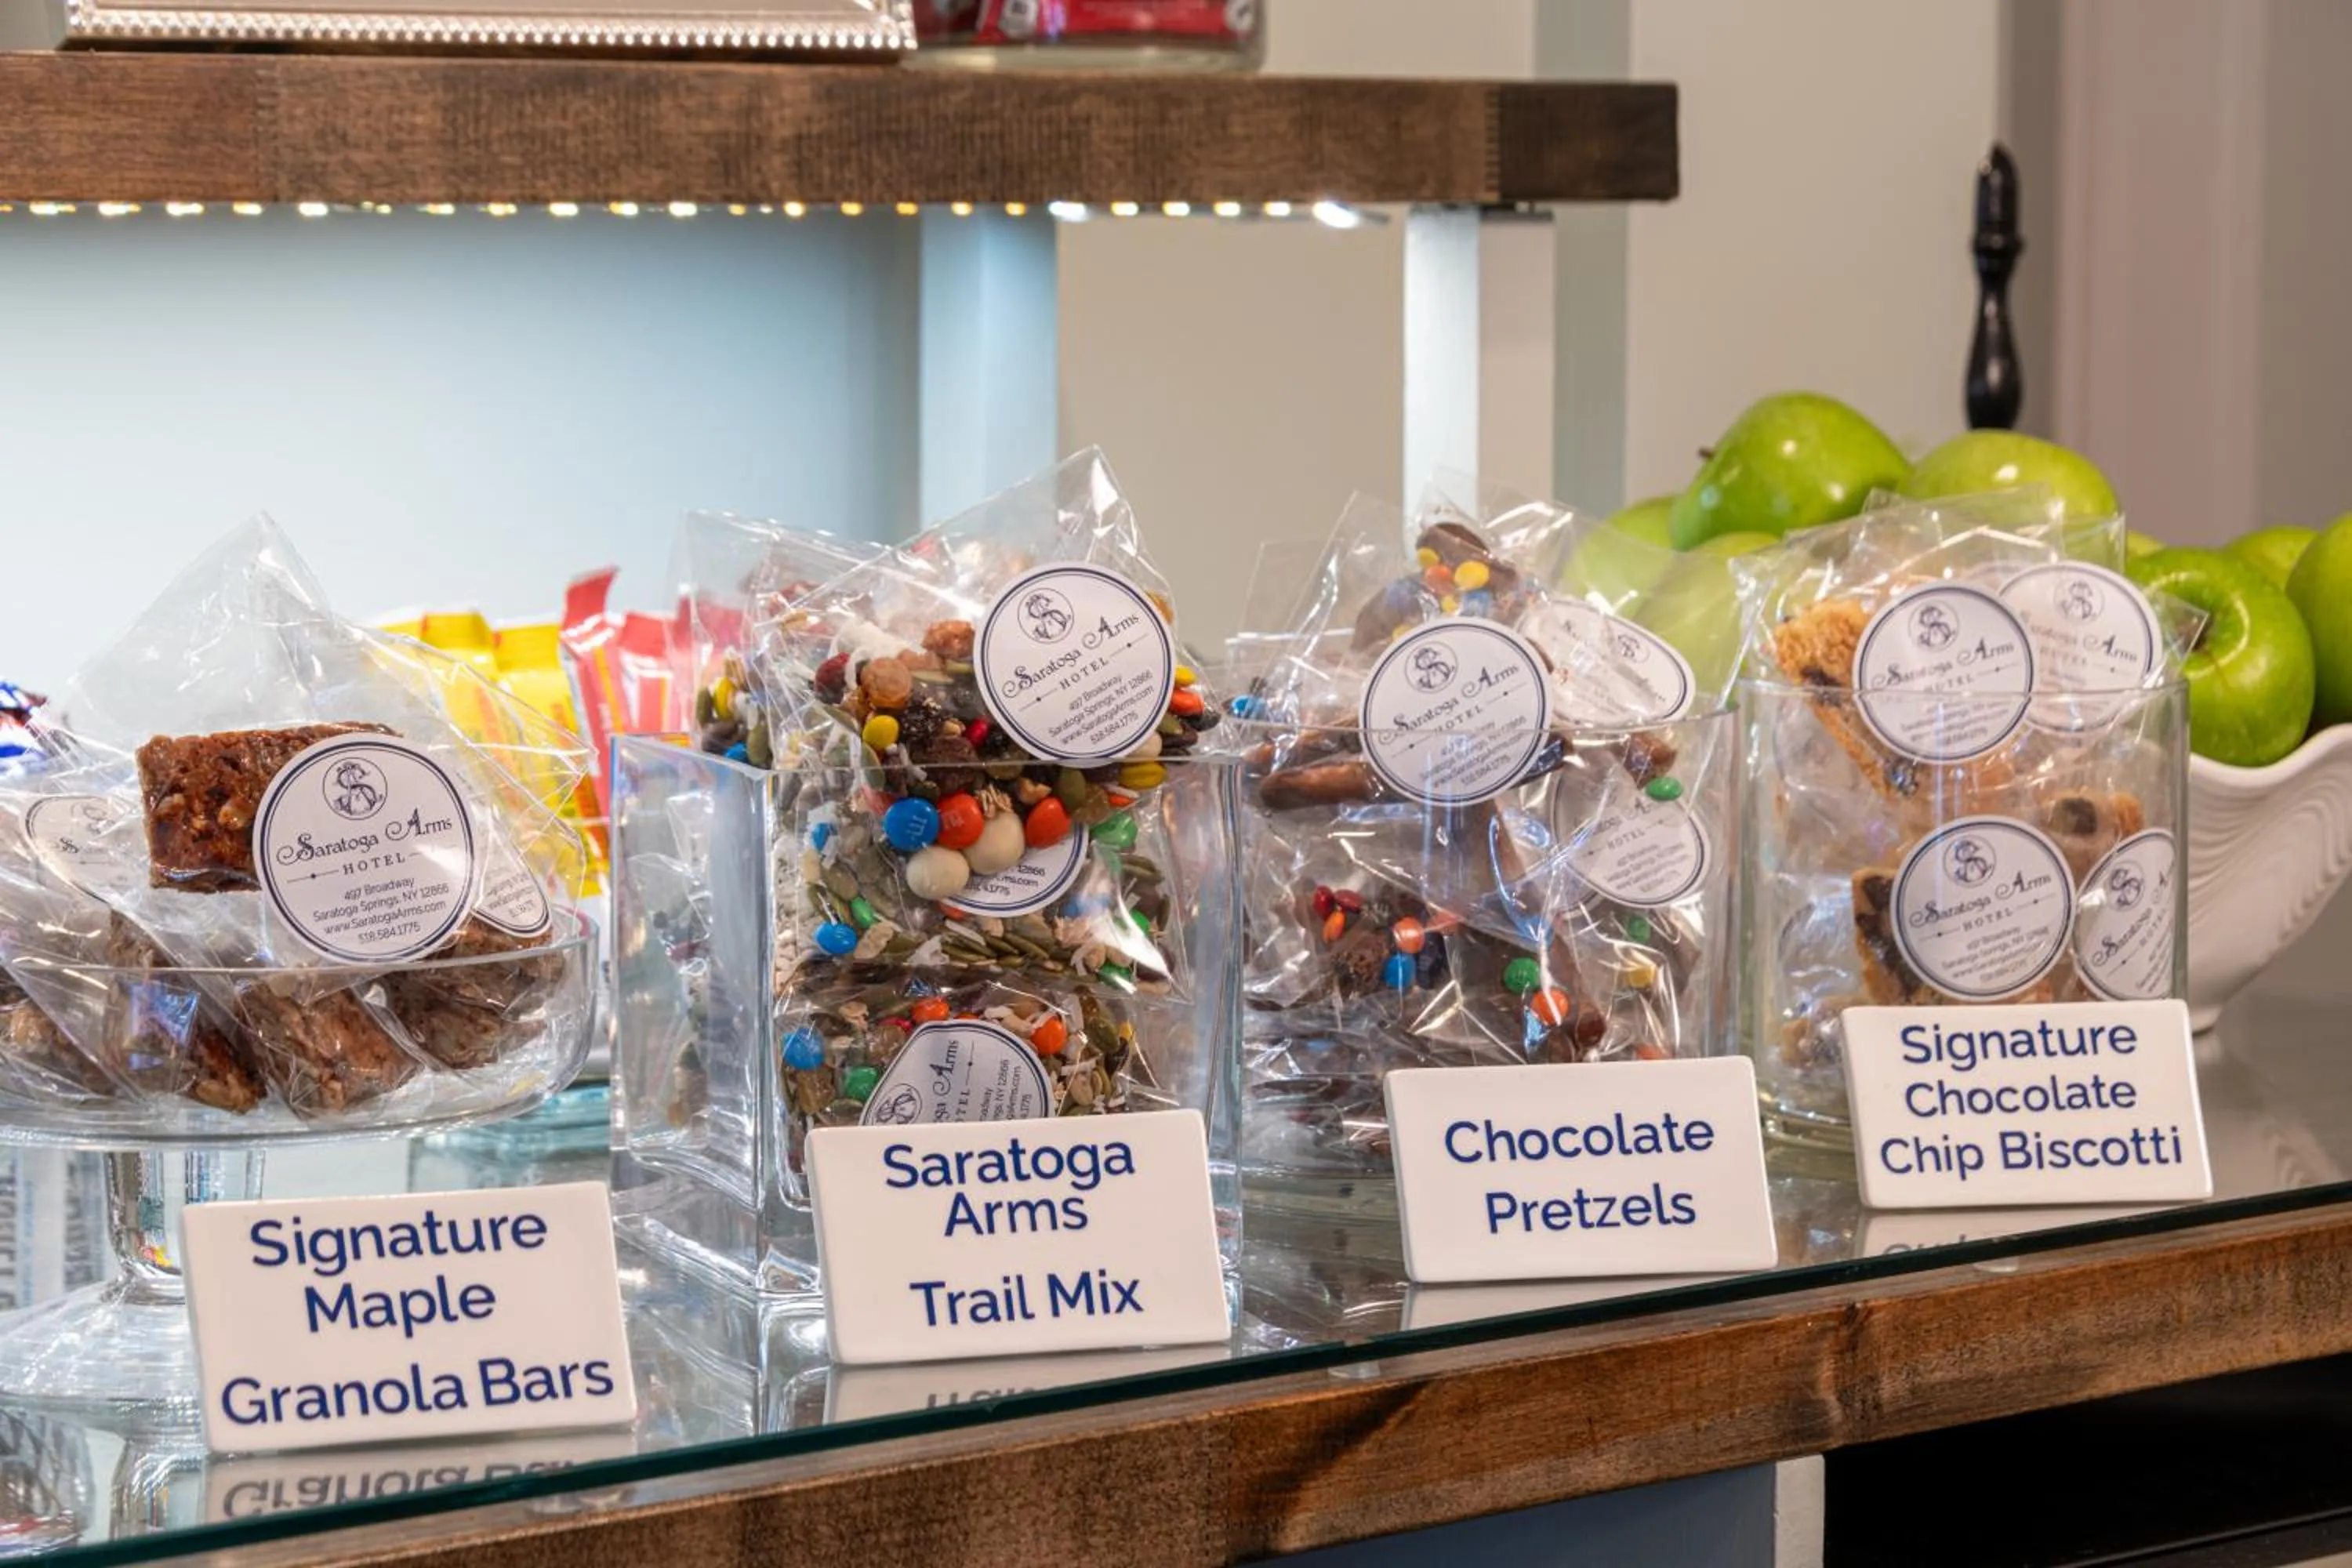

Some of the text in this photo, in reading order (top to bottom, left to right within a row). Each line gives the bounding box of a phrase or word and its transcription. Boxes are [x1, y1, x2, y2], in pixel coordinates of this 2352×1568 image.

[1002, 615, 1139, 699] Saratoga Arms
[1060, 657, 1109, 691] HOTEL
[1957, 637, 2015, 663] Arms
[1377, 697, 1459, 746] Saratoga
[1462, 663, 1519, 698] Arms
[276, 808, 453, 866] Saratoga Arms
[342, 852, 406, 876] HOTEL
[364, 877, 416, 895] Broadway
[314, 905, 359, 923] Saratoga
[402, 891, 418, 902] NY
[419, 883, 449, 898] 12866
[324, 901, 447, 935] www.SaratogaArms.com
[1909, 871, 2052, 928] Saratoga Arms
[930, 1040, 959, 1096] Arms
[1900, 1020, 2137, 1072] Signature
[1905, 1075, 2137, 1118] Chocolate
[1444, 1112, 1715, 1163] Chocolate
[1880, 1126, 2183, 1181] Chip Biscotti
[883, 1138, 1135, 1191] Saratoga
[944, 1192, 1088, 1237] Arms
[1485, 1182, 1697, 1234] Pretzels
[250, 1210, 547, 1276] Signature
[304, 1275, 496, 1338] Maple
[909, 1269, 1145, 1327] Trail Mix
[221, 1357, 615, 1425] Granola Bars
